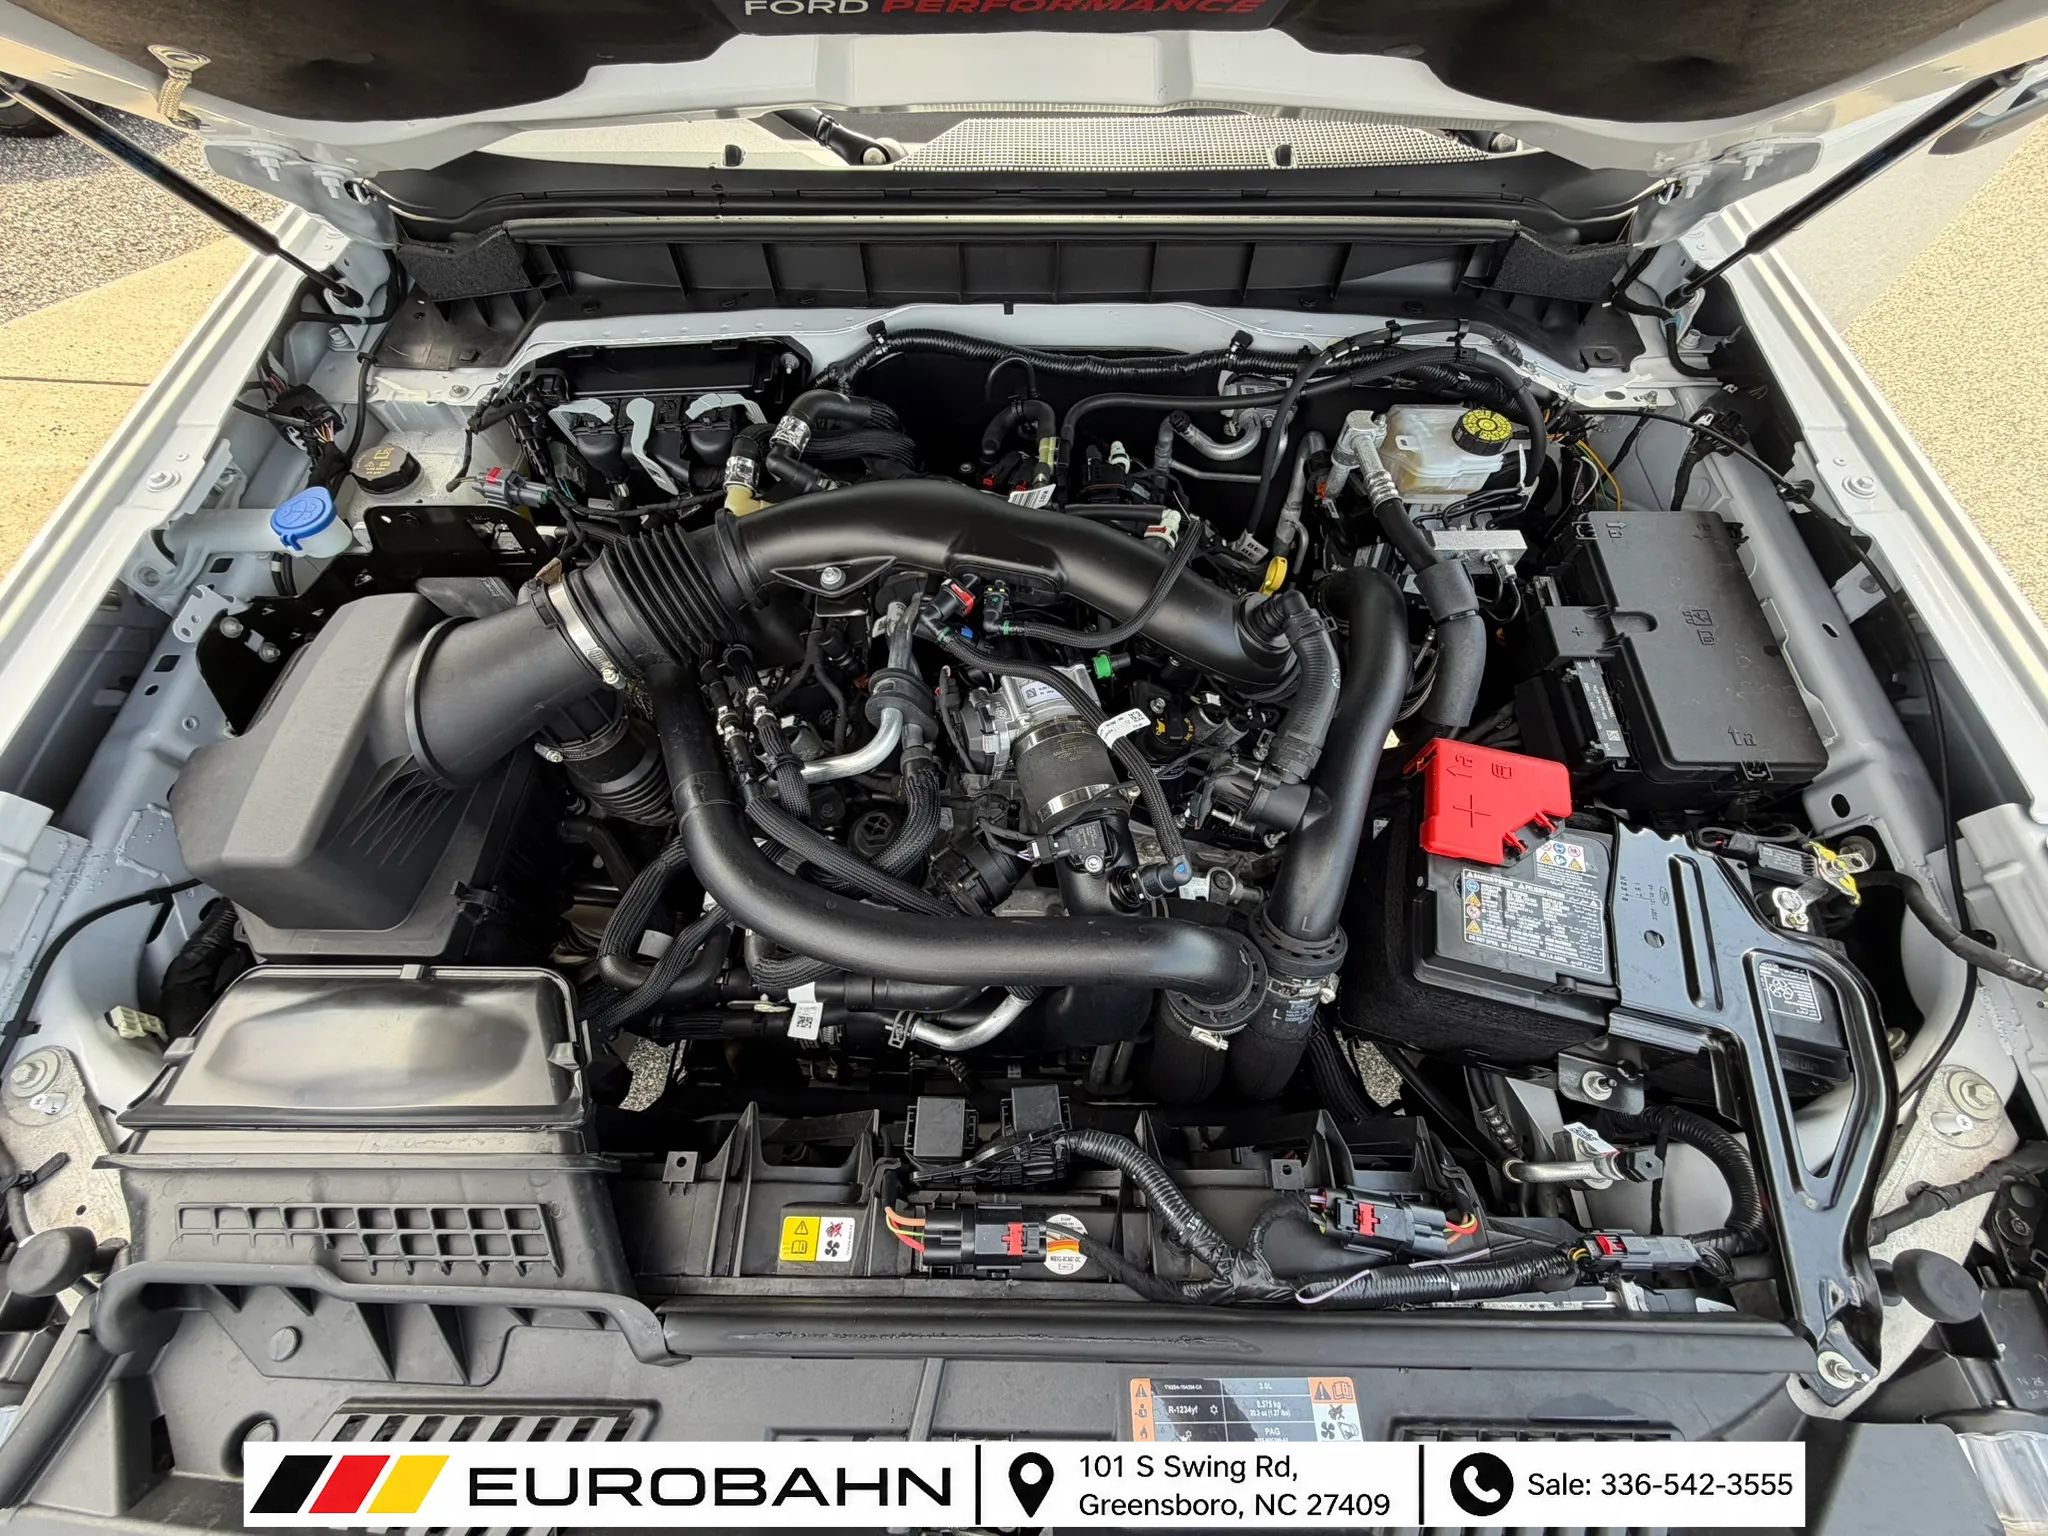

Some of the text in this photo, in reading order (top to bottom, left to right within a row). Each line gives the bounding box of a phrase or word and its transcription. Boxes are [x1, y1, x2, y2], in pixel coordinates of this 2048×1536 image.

[744, 0, 1266, 16] FORD PERFORMANCE
[1256, 1400, 1281, 1410] 0.575 kg
[1168, 1405, 1199, 1416] R-1234yf
[1264, 1428, 1281, 1436] PAG
